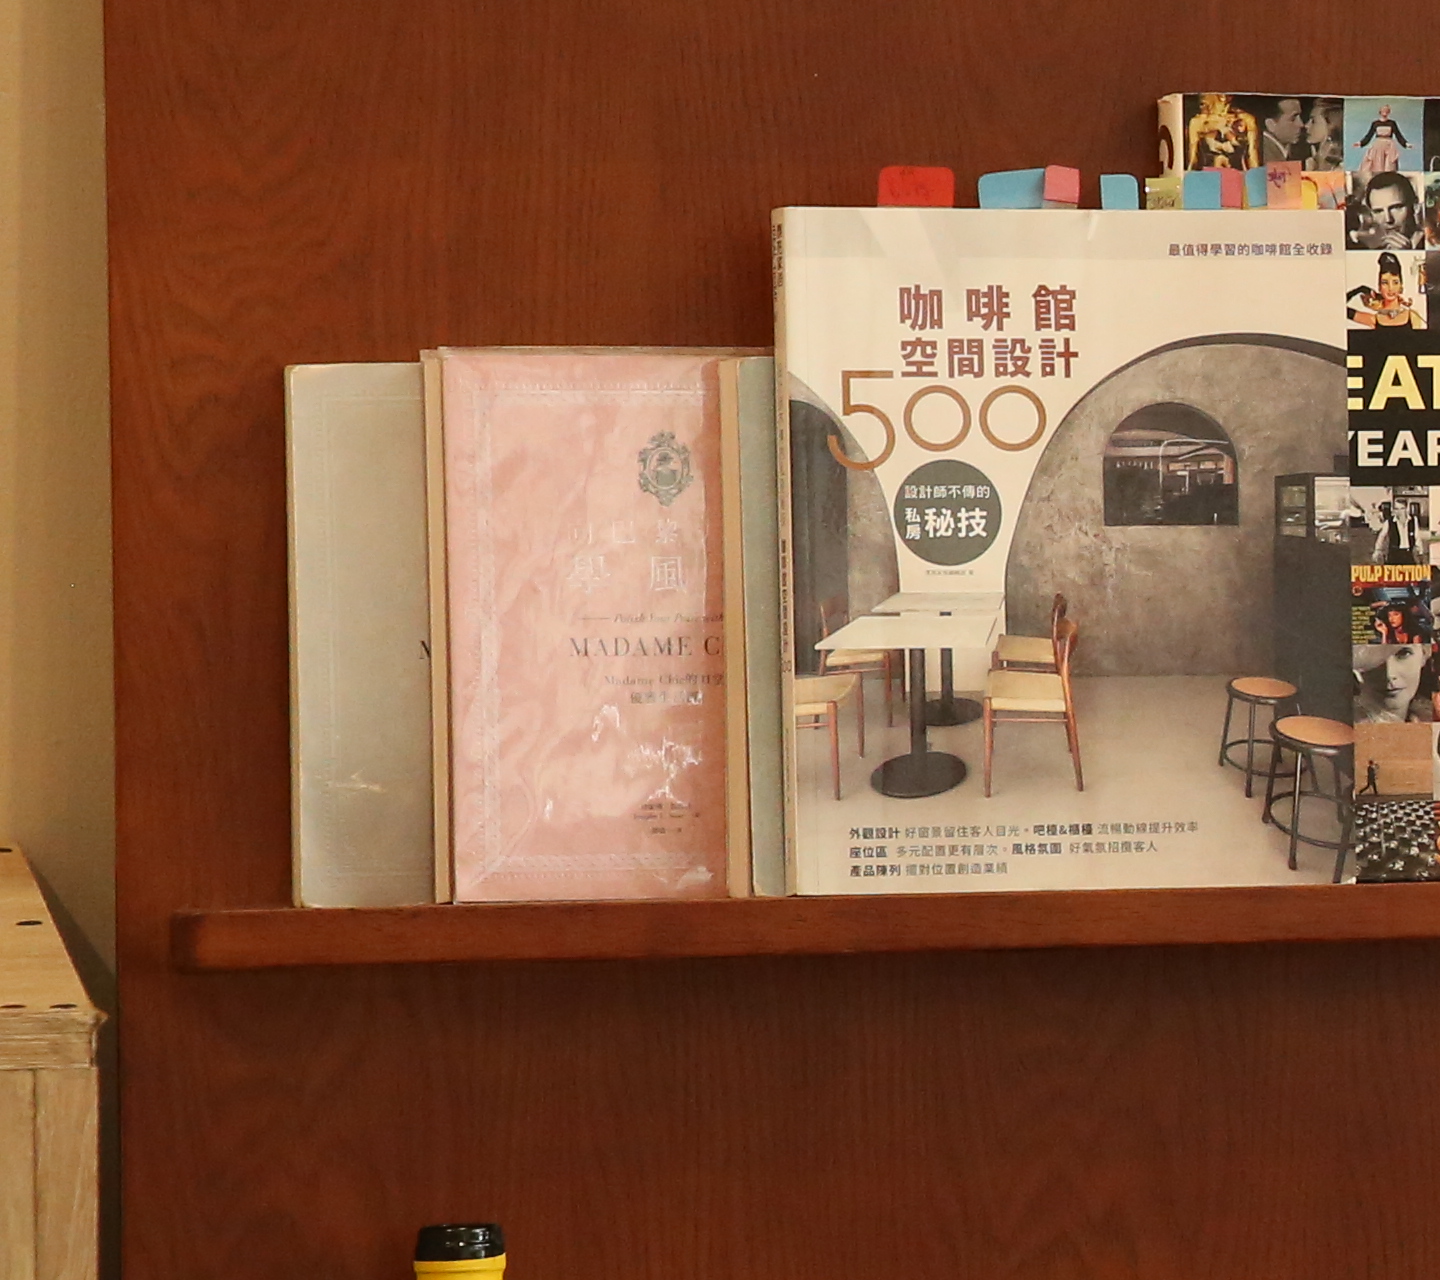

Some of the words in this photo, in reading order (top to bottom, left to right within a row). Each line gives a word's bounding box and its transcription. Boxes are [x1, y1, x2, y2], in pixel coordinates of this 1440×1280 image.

[1168, 243, 1333, 257] 最值得學習的咖啡館全收錄
[898, 284, 1077, 332] 咖啡館
[900, 337, 1079, 379] 空間設計
[827, 370, 1048, 471] 500
[904, 485, 990, 499] 設計師不傳的
[924, 507, 988, 538] 秘技
[1351, 565, 1383, 582] PULP
[1384, 565, 1431, 581] FICTION
[569, 637, 693, 657] MADAME
